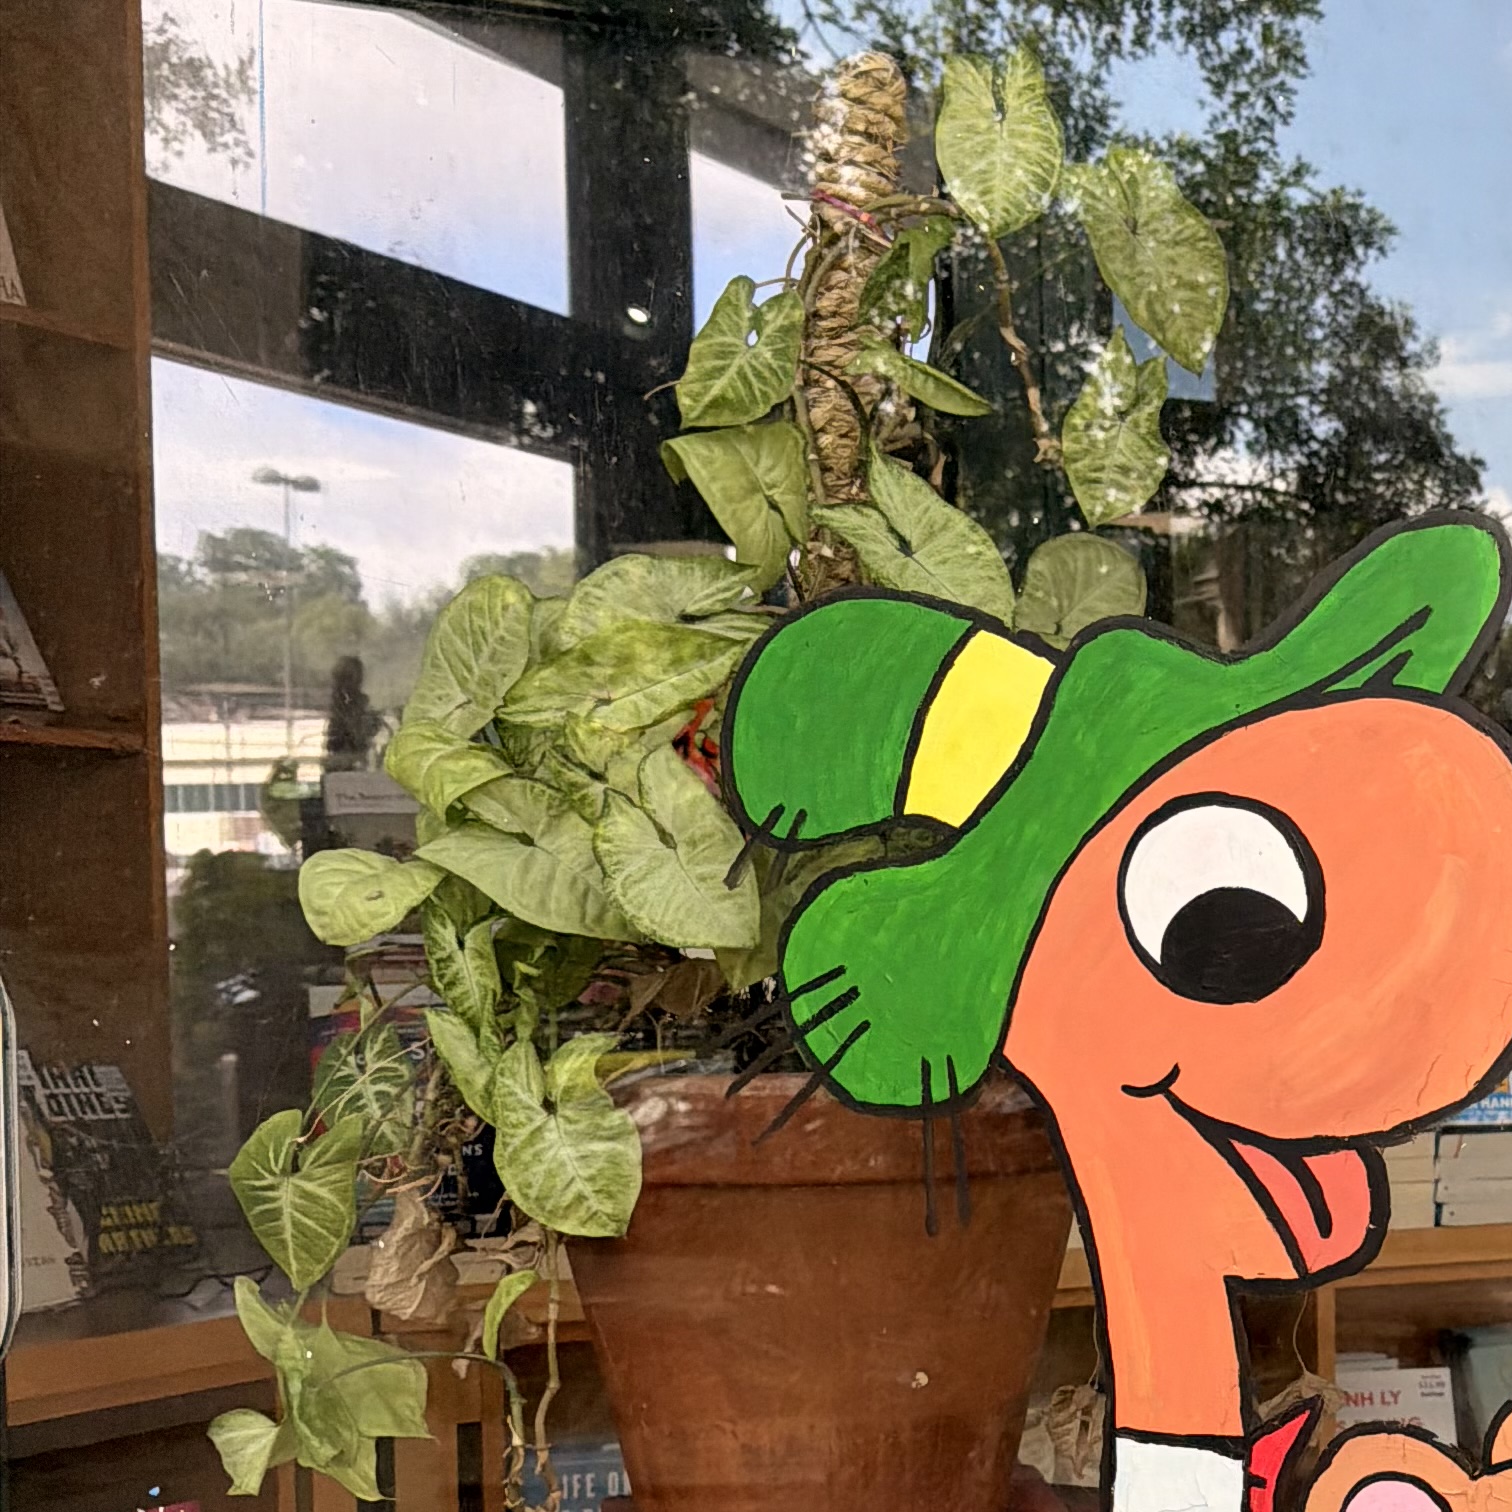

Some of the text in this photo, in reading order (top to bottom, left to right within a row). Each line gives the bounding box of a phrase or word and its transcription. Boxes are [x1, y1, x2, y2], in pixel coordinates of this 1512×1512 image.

[1343, 1390, 1401, 1407] NH LY
[562, 1473, 596, 1500] IFE
